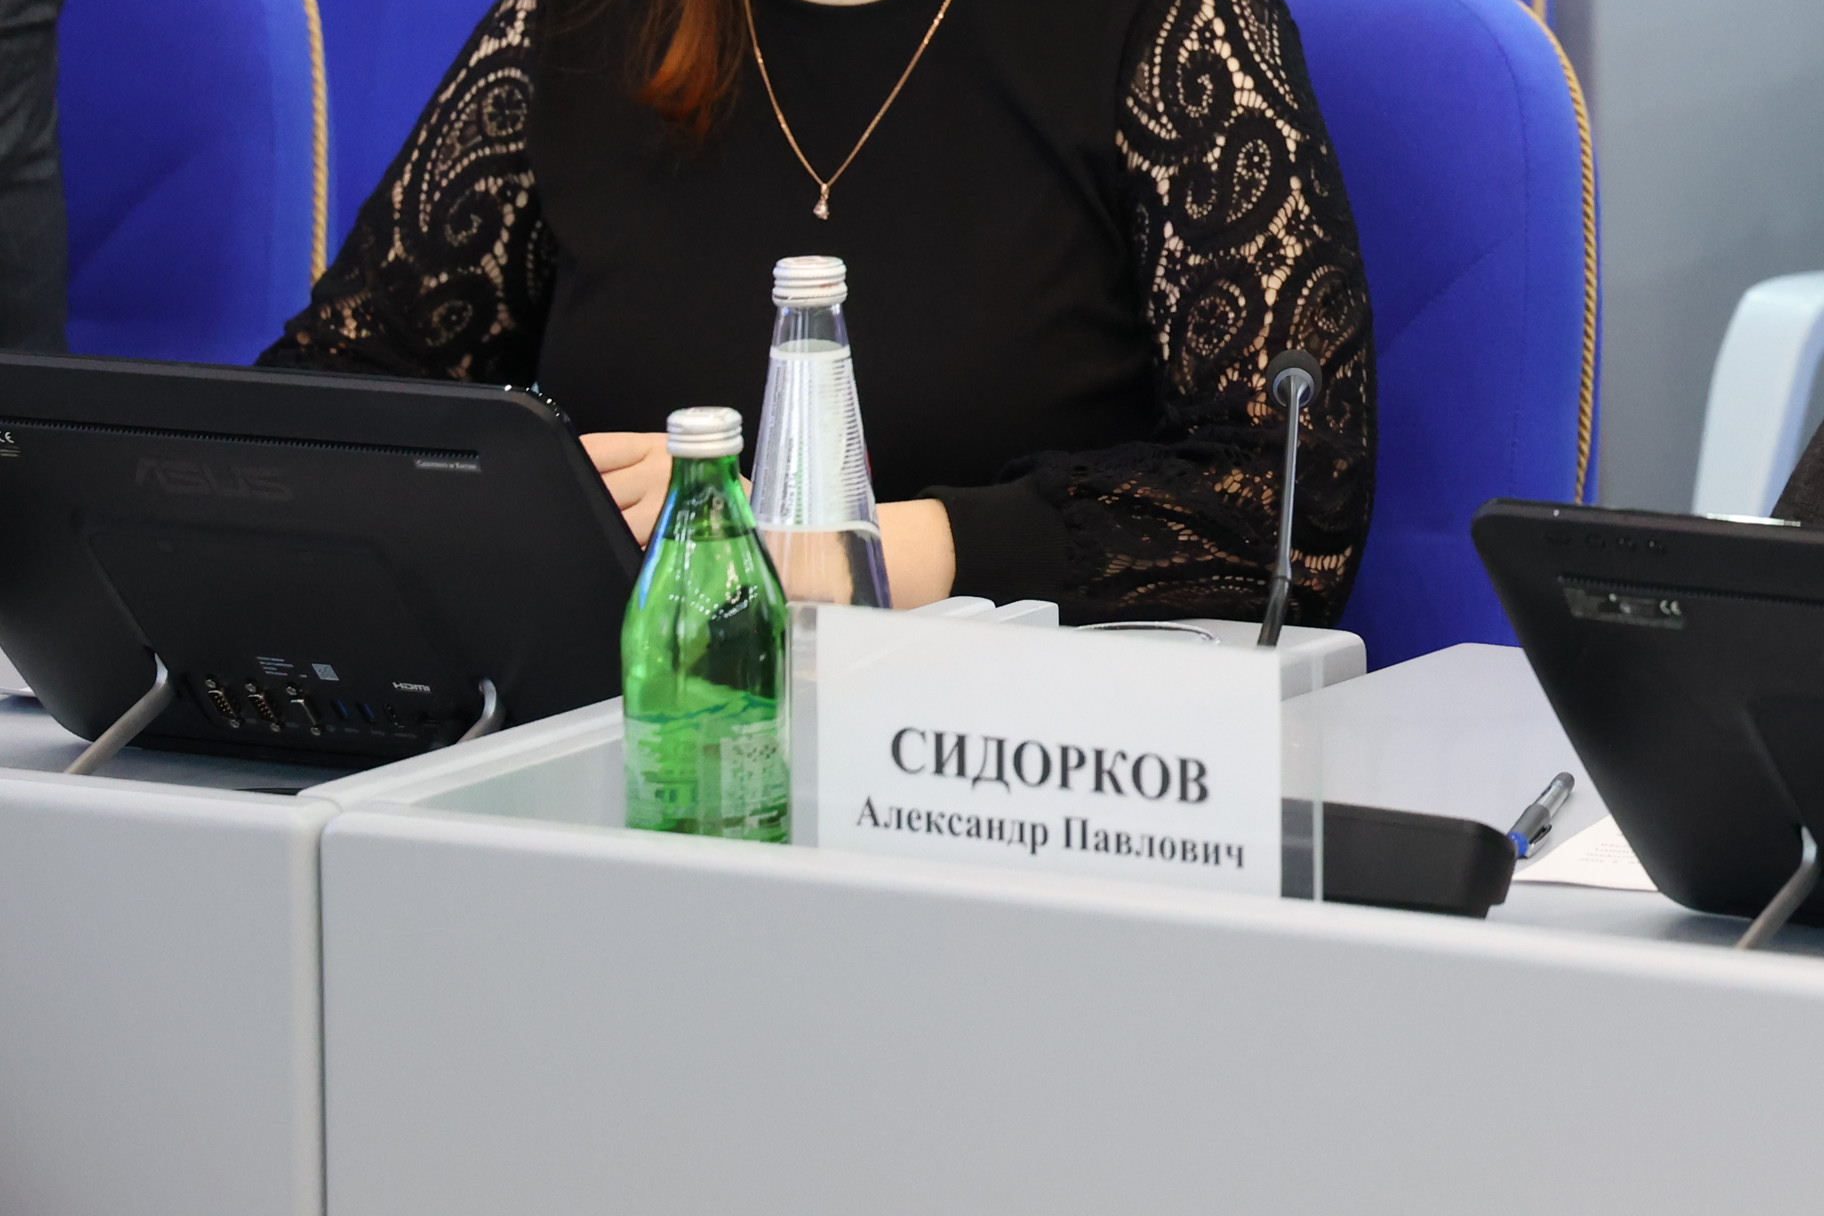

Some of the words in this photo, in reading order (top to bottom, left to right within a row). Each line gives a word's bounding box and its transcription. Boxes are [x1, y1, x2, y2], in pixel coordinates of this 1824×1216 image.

[135, 458, 294, 501] ASUS
[890, 726, 1210, 805] СИДОРКОВ
[856, 795, 1050, 855] Александр
[1063, 816, 1245, 869] Павлович
